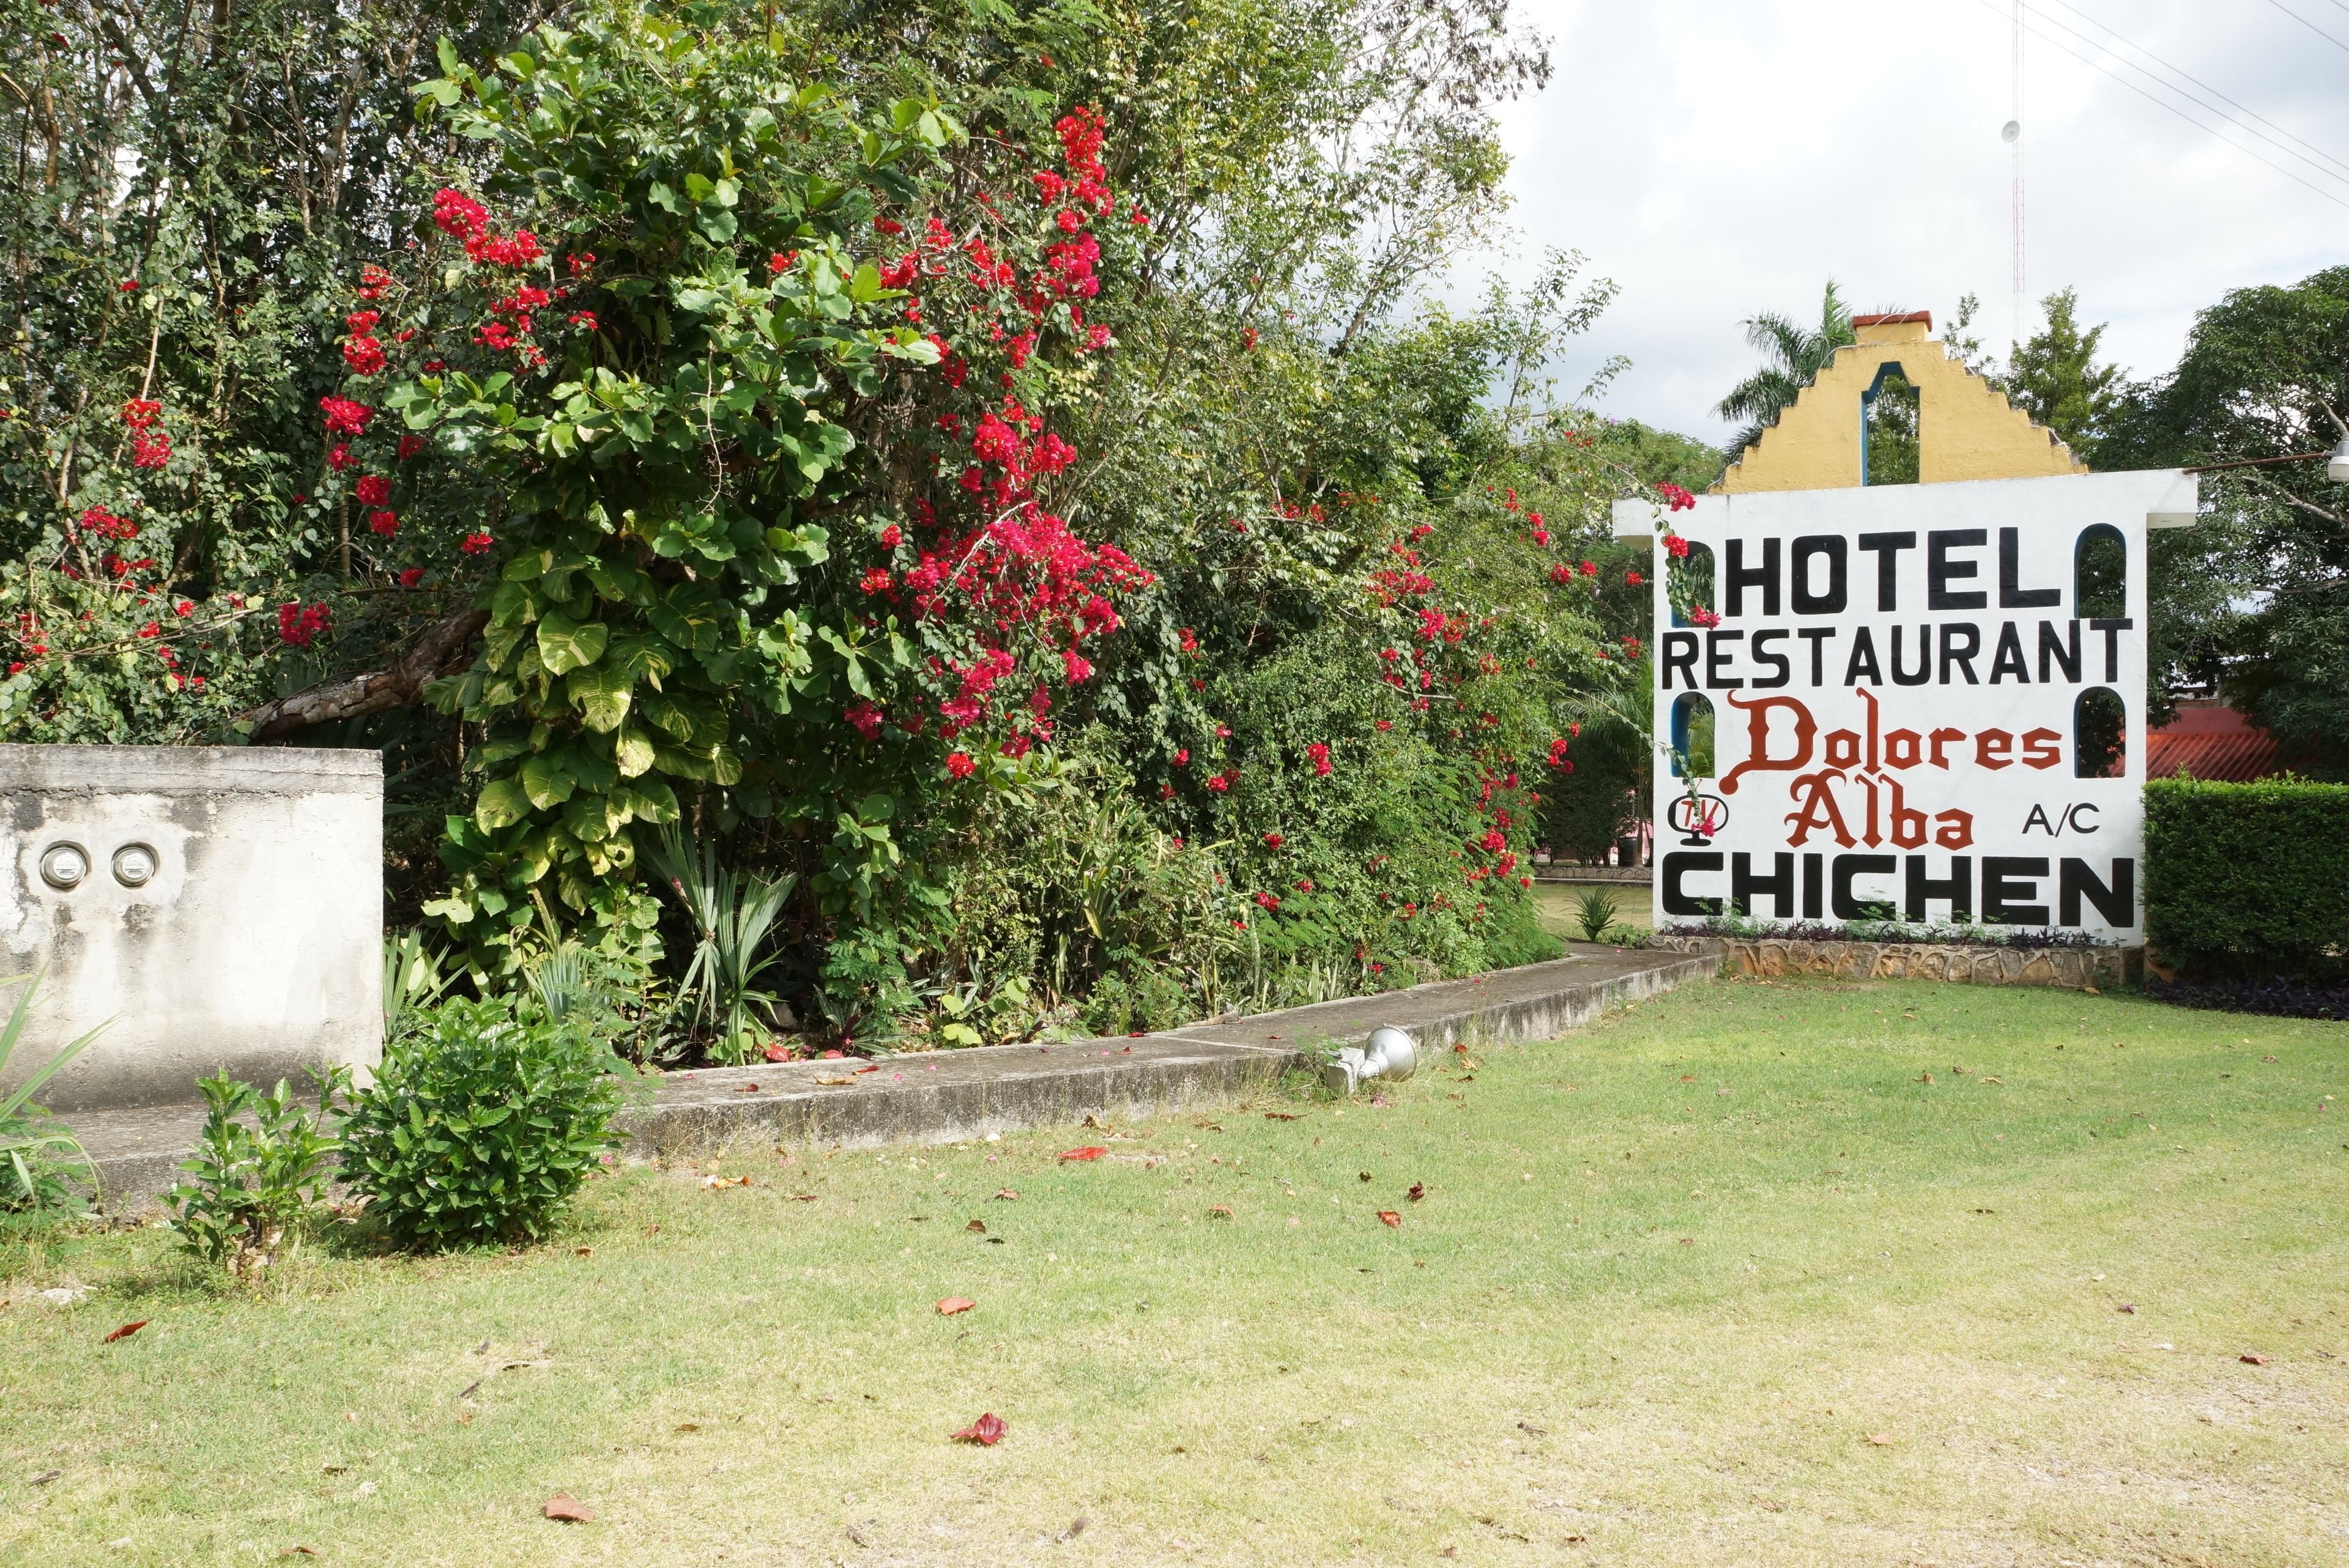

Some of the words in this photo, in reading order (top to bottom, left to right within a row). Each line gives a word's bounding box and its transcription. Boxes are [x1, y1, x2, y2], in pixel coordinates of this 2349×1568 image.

[1725, 527, 2061, 616] HOTEL
[1661, 618, 2133, 690] RESTAURANT
[1719, 689, 2063, 794] Dolores
[1681, 799, 1719, 828] TV
[1786, 768, 1975, 850] Alba
[2022, 802, 2100, 839] A/C
[1661, 851, 2134, 927] CHICHEN
